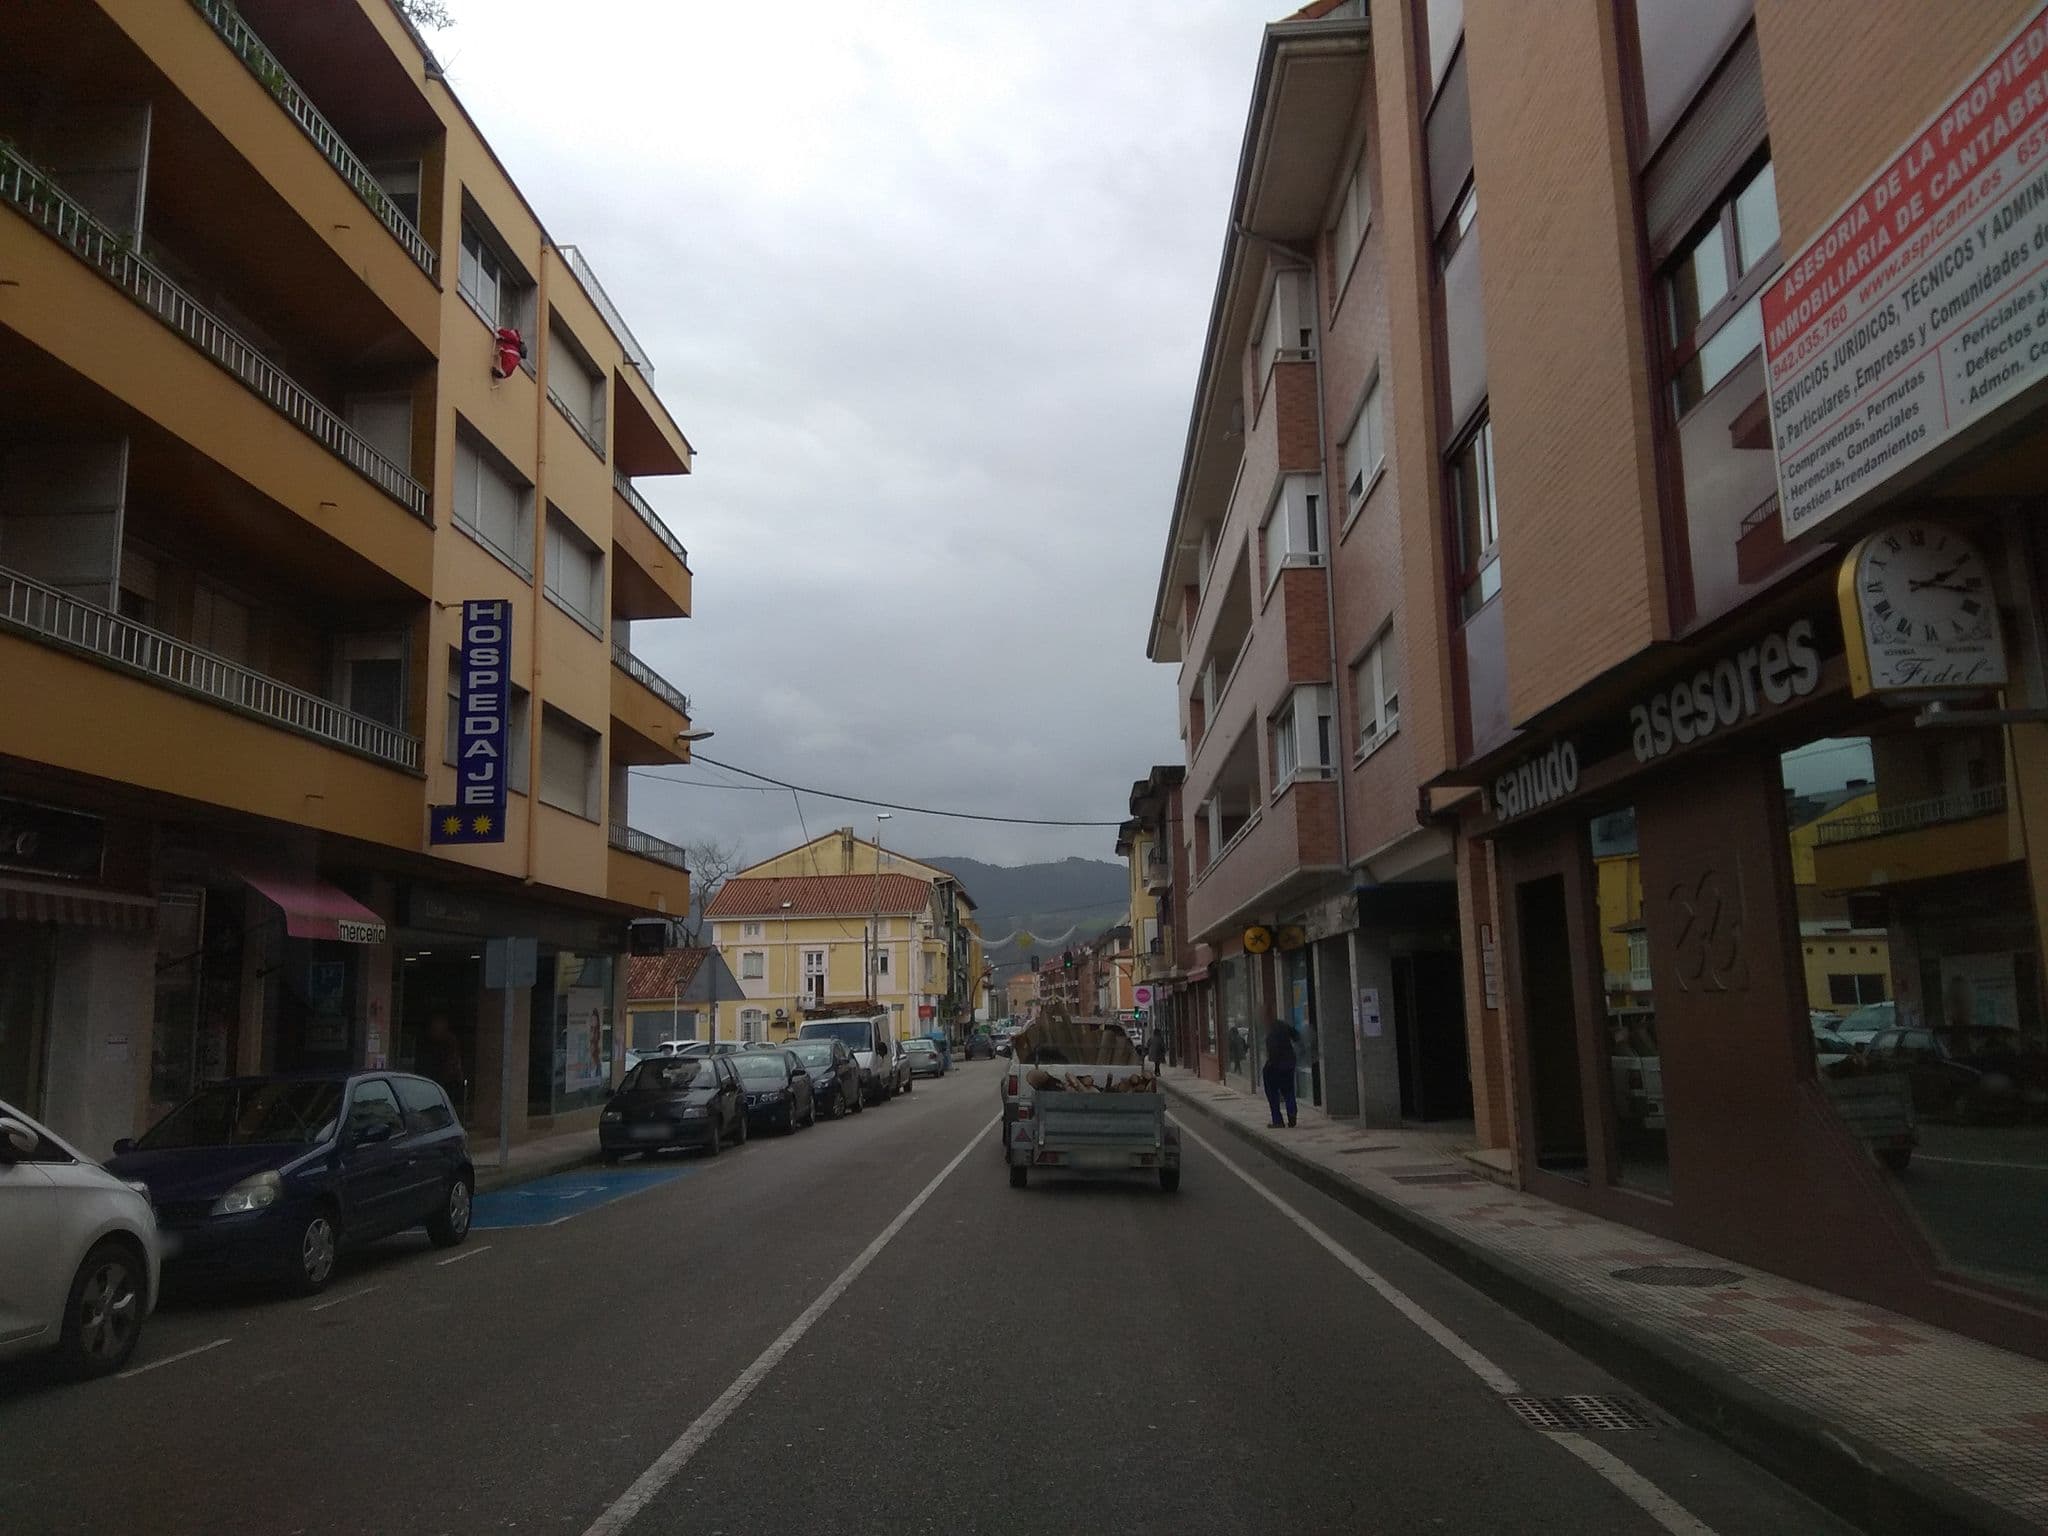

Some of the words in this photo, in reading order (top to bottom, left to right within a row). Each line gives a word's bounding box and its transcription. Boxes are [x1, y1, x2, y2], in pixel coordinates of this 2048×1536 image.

[1784, 203, 1870, 303] ASESORIA
[1873, 170, 1901, 213] DE
[1906, 140, 1936, 181] LA
[1940, 10, 2048, 148] PROPIED
[1769, 224, 1891, 353] INMOBILIARIA
[1895, 191, 1925, 235] DE
[1773, 360, 1829, 419] SERVICIOS
[1976, 223, 1988, 249] Y
[1786, 384, 1850, 443] Particulares
[1918, 322, 1927, 347] y
[1930, 242, 2030, 330] Comunidades
[1962, 289, 2036, 352] Periciales
[1867, 370, 1926, 422] Permutas
[1966, 322, 2032, 378] Defectos
[1833, 424, 1926, 494] Arrendamientos
[464, 603, 503, 805] HOSPEDAJE
[1629, 617, 1819, 763] asesores
